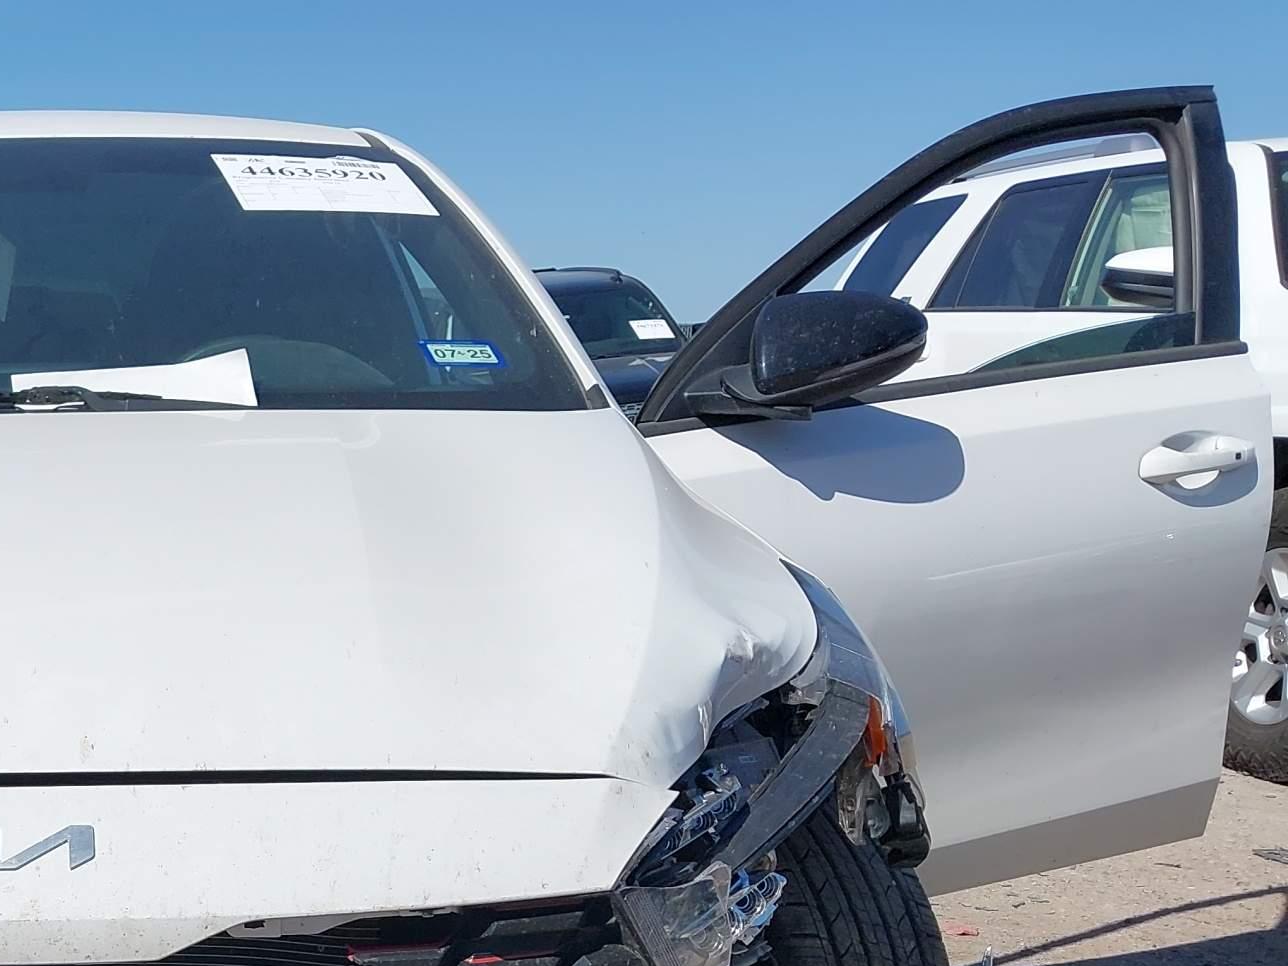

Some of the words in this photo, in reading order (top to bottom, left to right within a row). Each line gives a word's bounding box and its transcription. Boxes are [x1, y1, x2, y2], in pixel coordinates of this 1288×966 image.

[241, 165, 387, 182] 44635920
[434, 348, 455, 359] 07
[467, 349, 493, 359] 25
